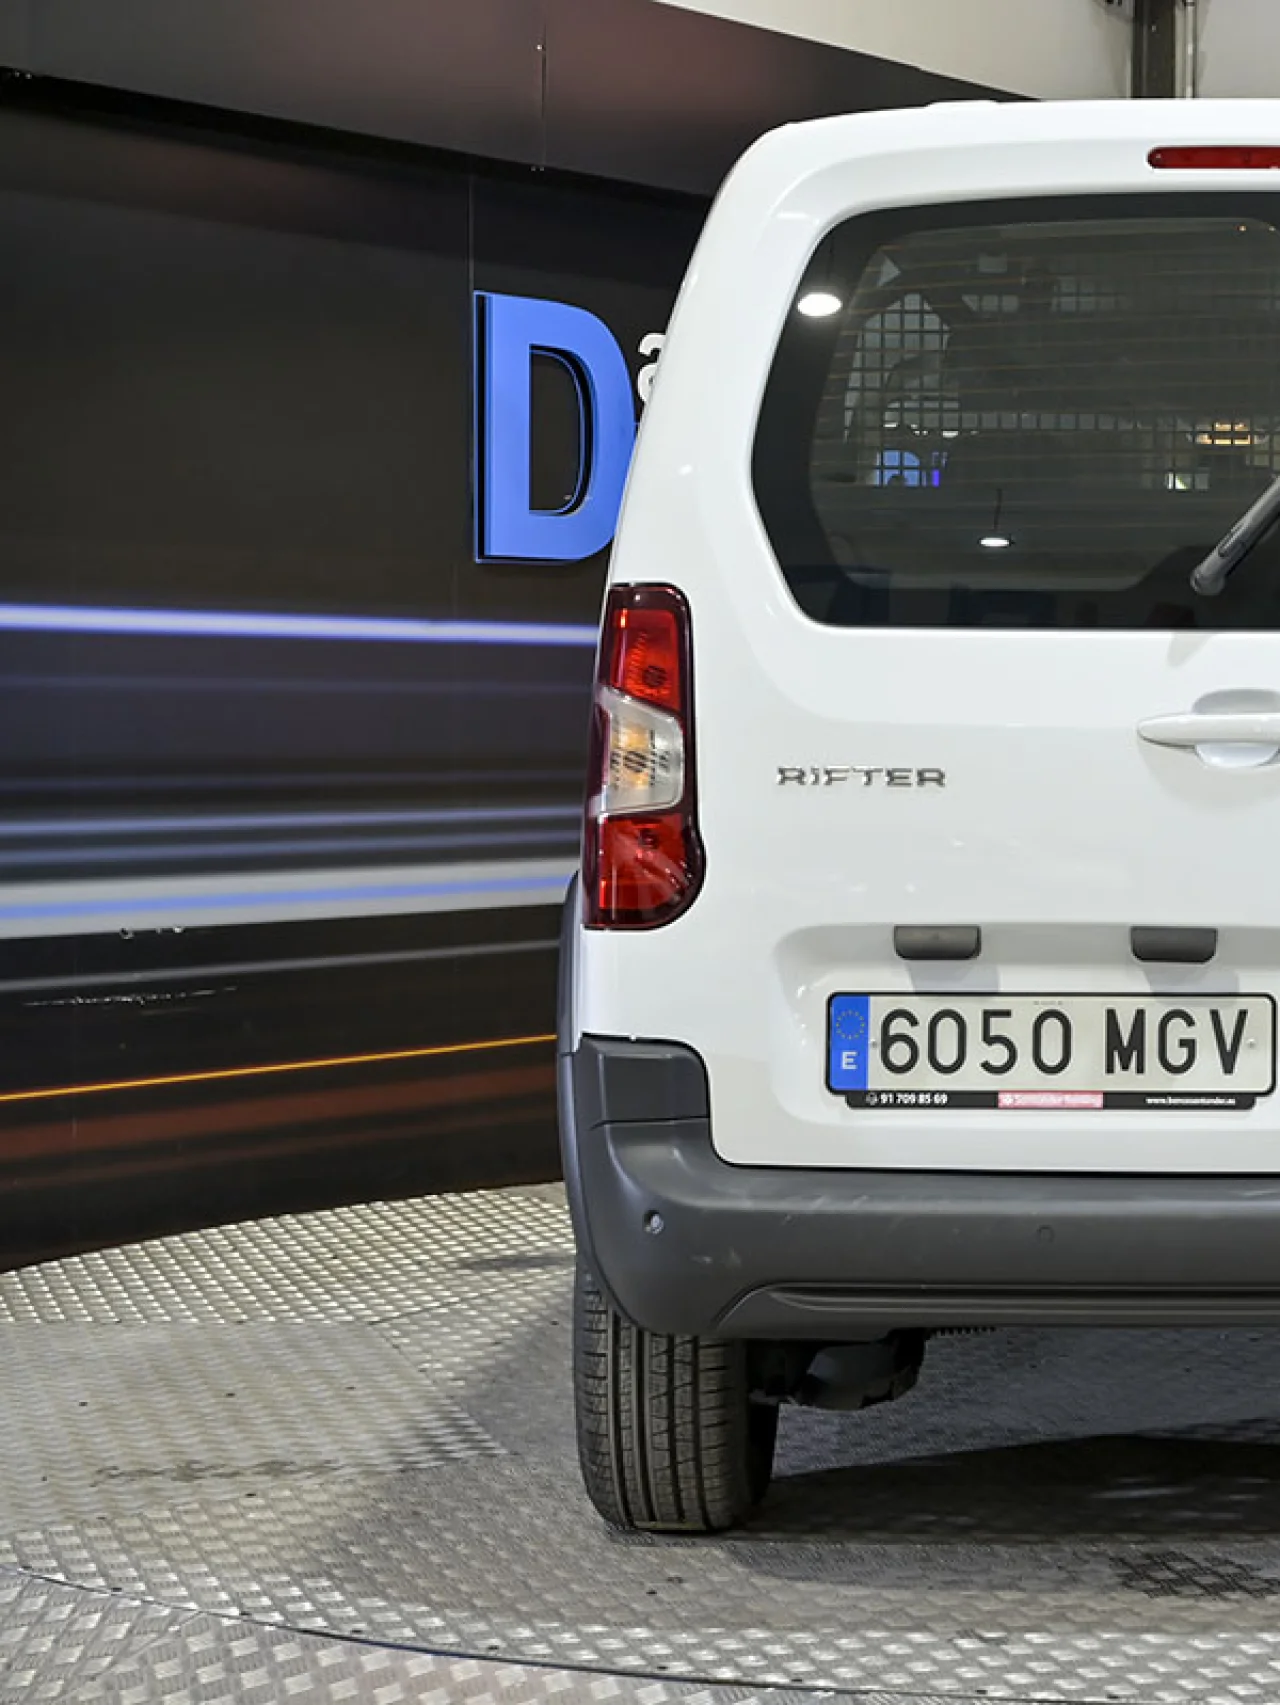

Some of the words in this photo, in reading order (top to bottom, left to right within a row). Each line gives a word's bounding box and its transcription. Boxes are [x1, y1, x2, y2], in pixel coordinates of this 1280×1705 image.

[474, 291, 637, 564] D
[776, 766, 946, 787] RIFTER
[841, 1051, 857, 1070] E
[880, 1008, 1072, 1074] 6050
[1105, 1008, 1248, 1074] MGV
